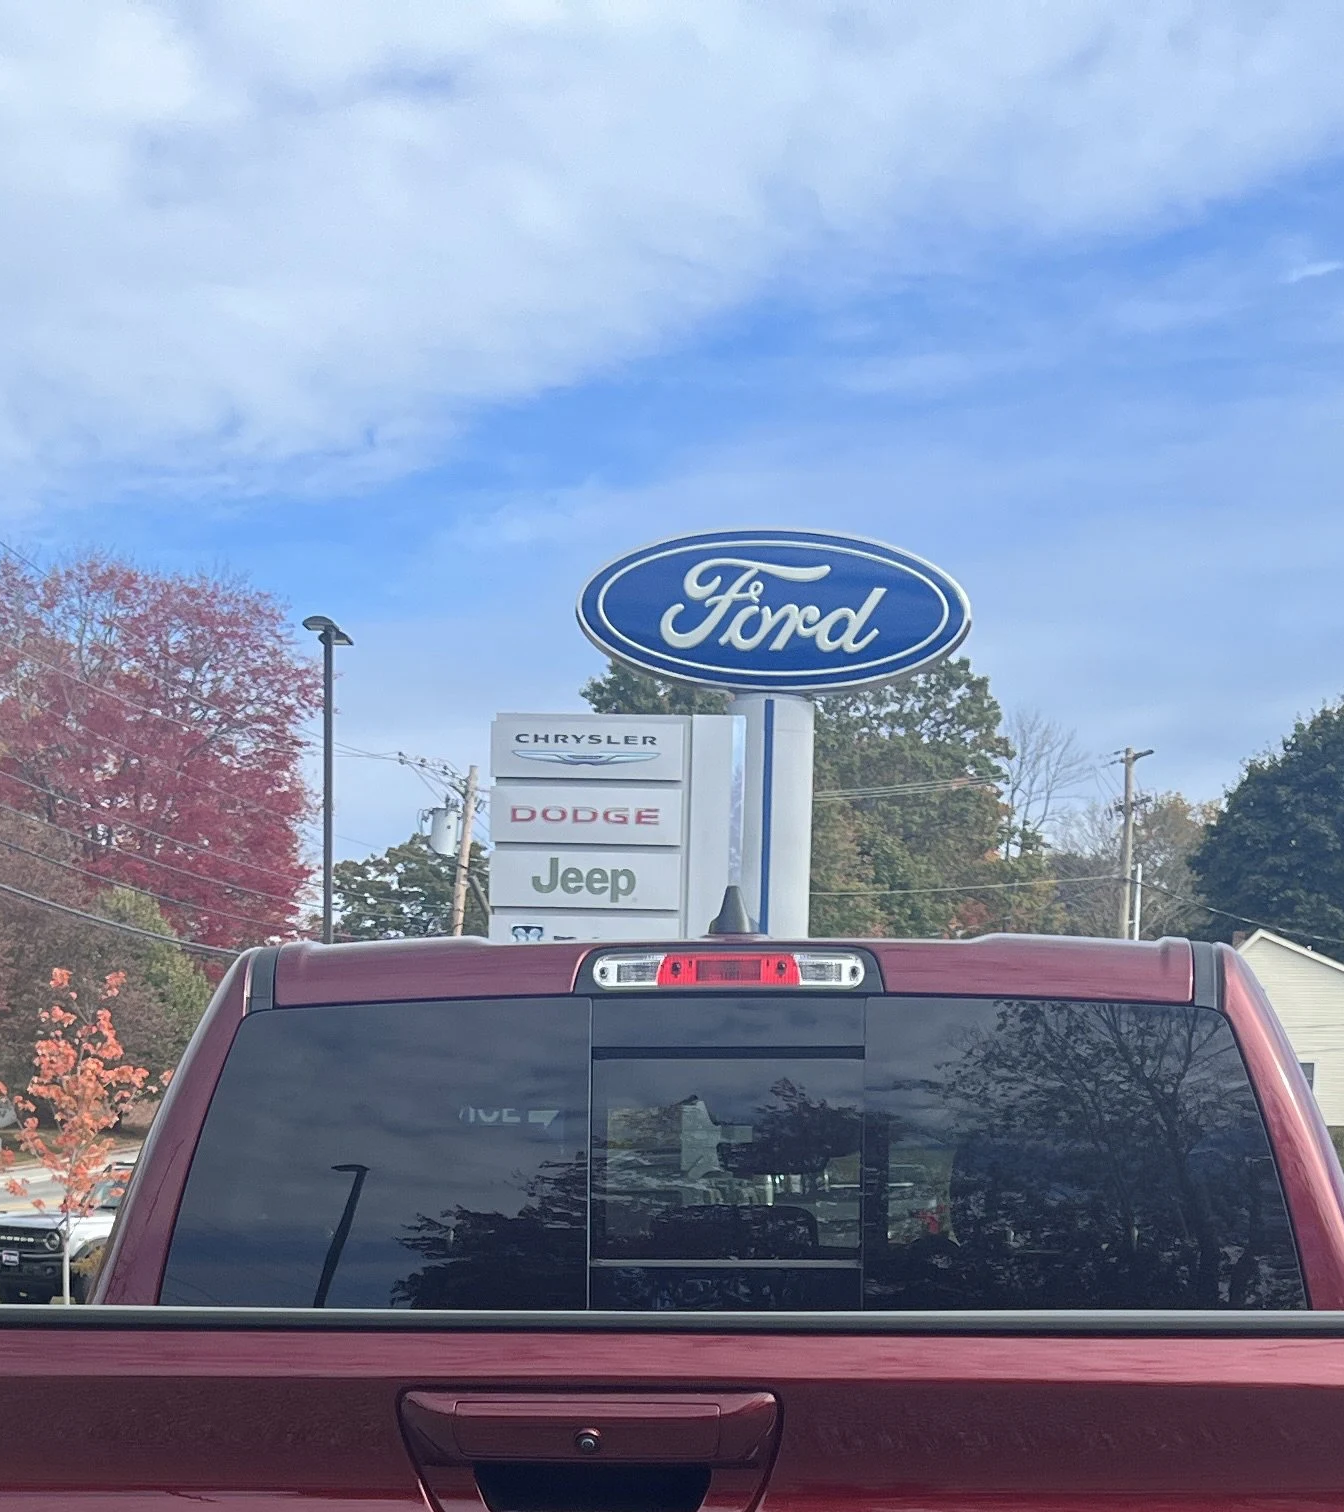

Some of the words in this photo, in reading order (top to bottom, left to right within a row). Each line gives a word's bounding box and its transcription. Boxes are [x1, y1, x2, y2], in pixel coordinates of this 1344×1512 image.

[661, 558, 887, 653] Ford
[515, 733, 658, 746] CHRYSLER
[510, 805, 660, 825] DODGE
[531, 857, 637, 903] Jeep
